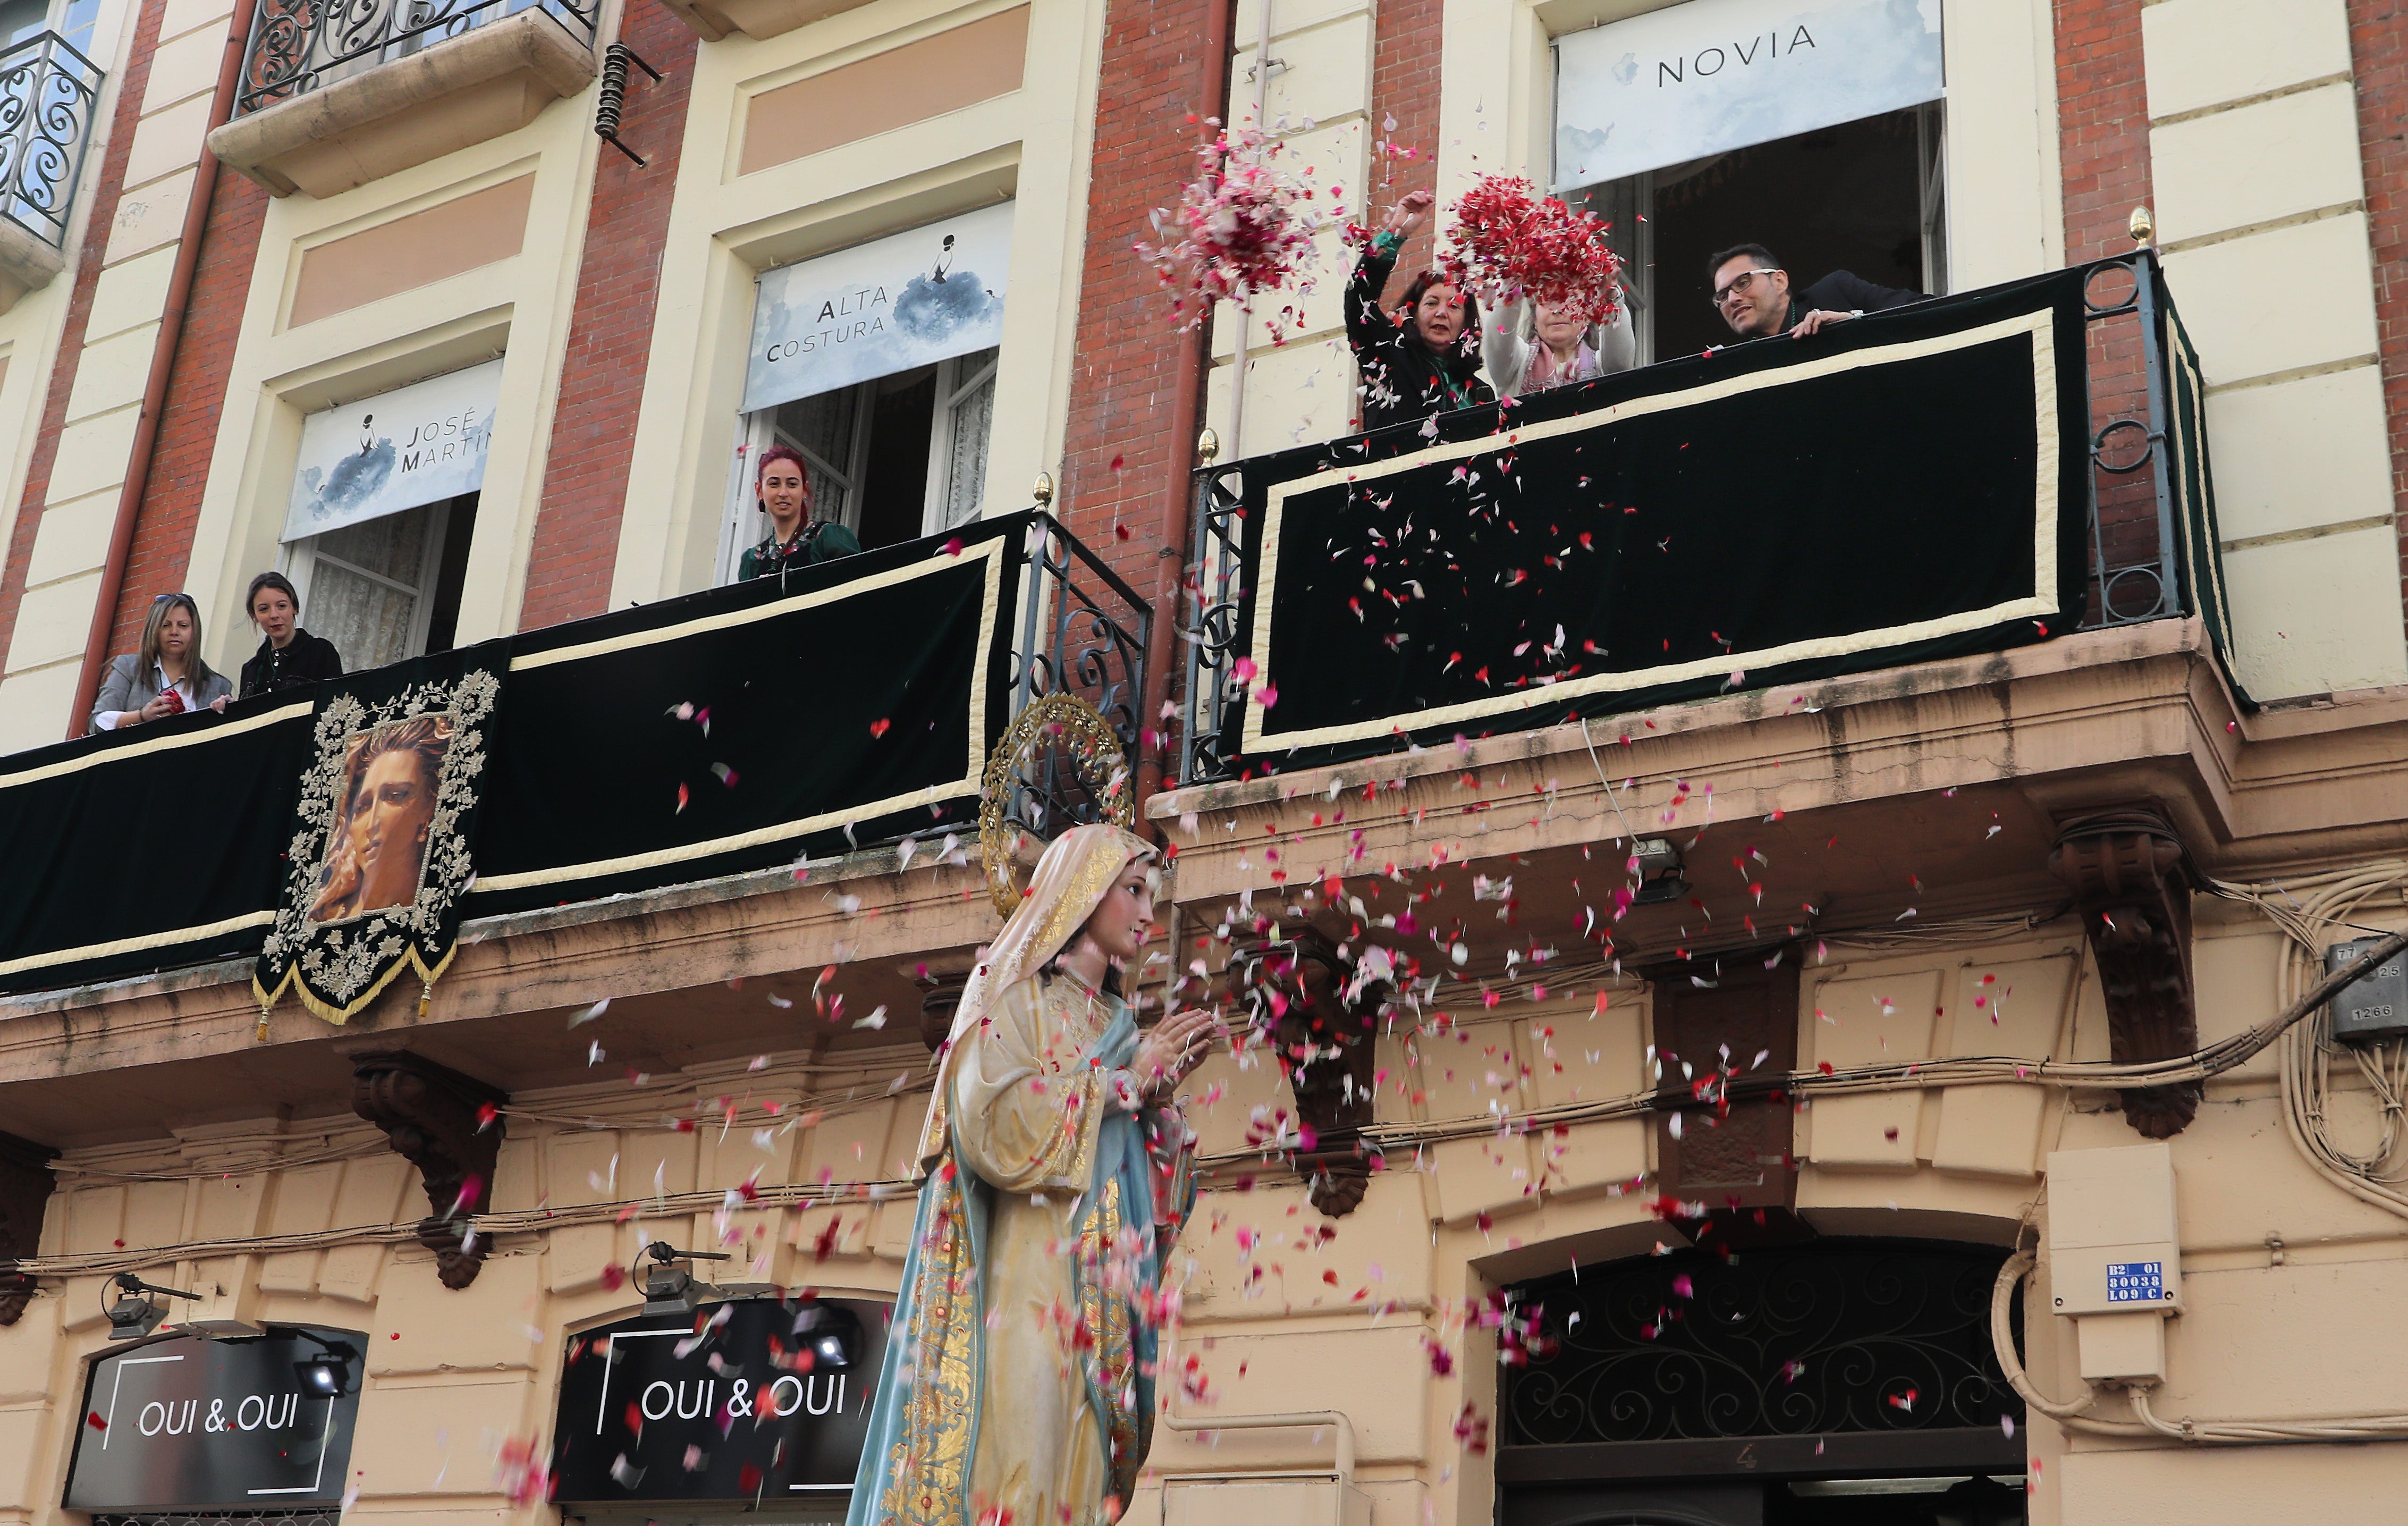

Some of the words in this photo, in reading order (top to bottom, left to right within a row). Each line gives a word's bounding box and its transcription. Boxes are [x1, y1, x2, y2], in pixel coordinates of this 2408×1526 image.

[1658, 24, 1816, 88] NOVIA
[816, 286, 888, 323] ALTA
[766, 317, 884, 362] COSTURA
[406, 406, 476, 448] JOSÉ
[2338, 948, 2355, 959] 77
[2354, 1006, 2391, 1019] 1266
[2108, 1265, 2126, 1276] B2
[2144, 1263, 2159, 1274] 01
[2109, 1276, 2160, 1288] 80038
[2109, 1289, 2139, 1300] L09
[2148, 1288, 2157, 1299] C
[641, 1379, 714, 1420] OUI
[726, 1378, 753, 1417] &
[769, 1374, 846, 1417] OUI
[139, 1399, 197, 1437] OUI
[204, 1398, 225, 1432] &
[237, 1393, 299, 1431] OUI
[1736, 1444, 1758, 1470] 4
